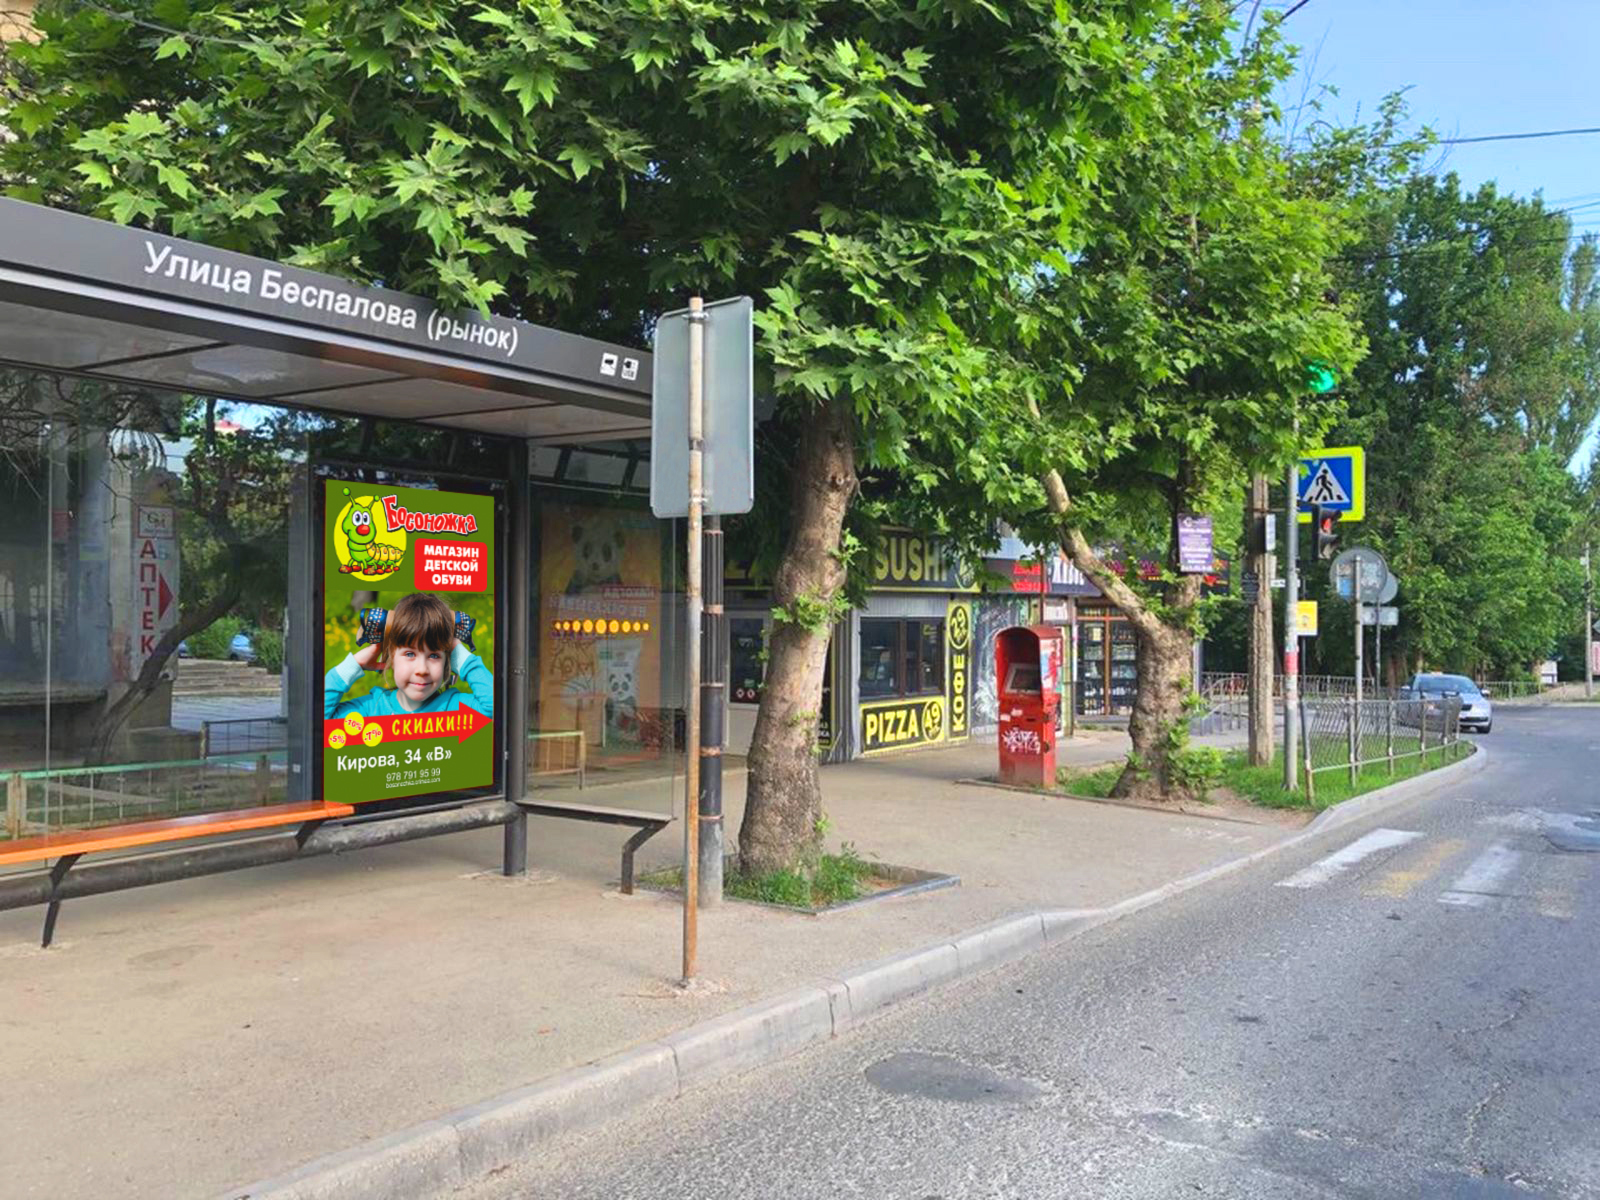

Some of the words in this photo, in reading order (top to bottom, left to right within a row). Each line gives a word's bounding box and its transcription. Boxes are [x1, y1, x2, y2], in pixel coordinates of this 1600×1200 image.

[144, 240, 252, 293] Улица
[260, 268, 418, 329] Беспалова
[427, 309, 519, 357] (рынок)
[381, 494, 478, 536] Босоножка
[424, 544, 479, 558] МАГАЗИН
[424, 559, 478, 572] ДЕТСКОЙ
[432, 573, 472, 586] ОБУВИ
[139, 539, 157, 656] АПТЕК
[953, 654, 965, 732] КОФЕ
[391, 713, 474, 736] СКИДКИ!!!
[866, 707, 920, 745] PIZZA
[329, 735, 345, 744] -5%
[337, 753, 400, 773] Кирова,
[404, 748, 422, 764] 34
[426, 746, 452, 761] «В»
[386, 772, 401, 782] 978
[403, 770, 417, 781] 791
[419, 768, 429, 778] 95
[431, 767, 441, 777] 99
